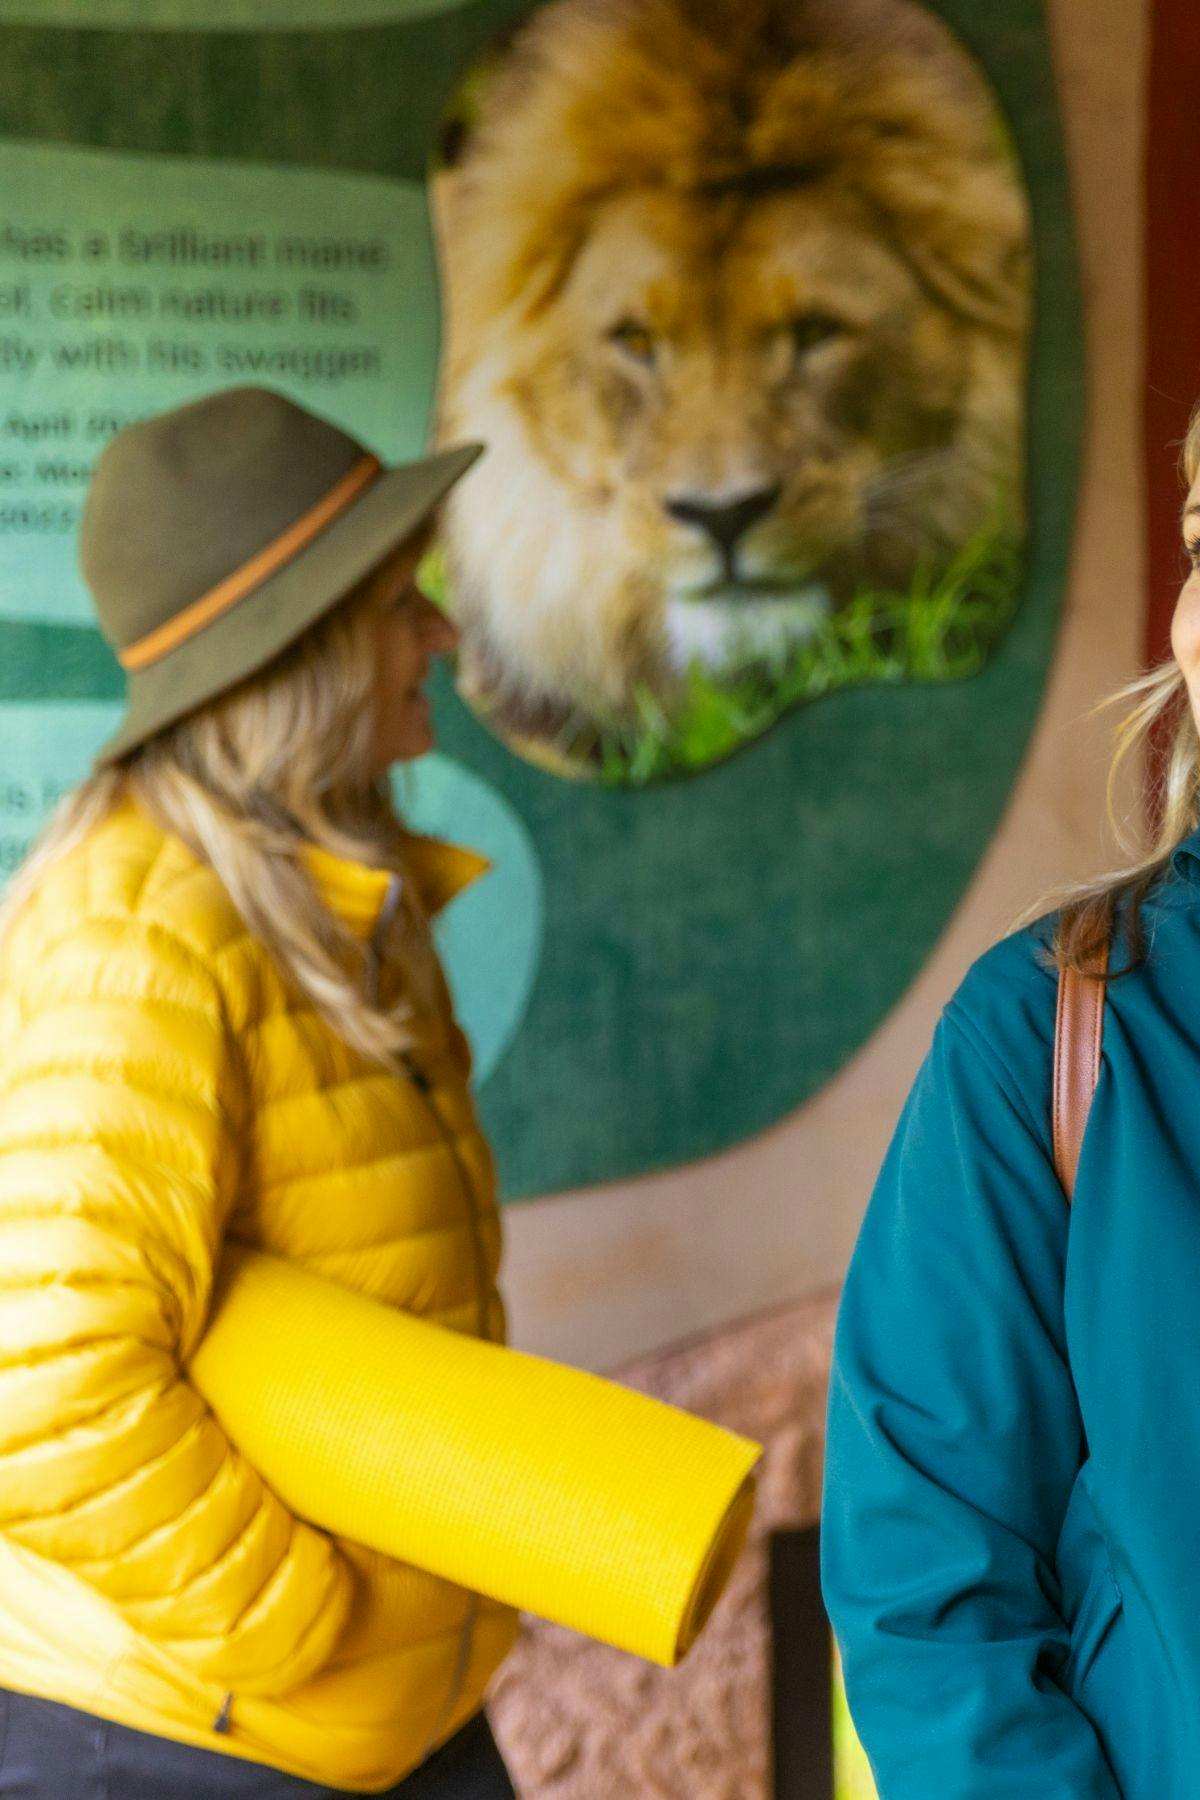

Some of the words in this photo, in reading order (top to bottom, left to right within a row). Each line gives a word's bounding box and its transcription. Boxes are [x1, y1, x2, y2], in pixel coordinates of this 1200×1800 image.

[84, 231, 106, 264] a
[119, 226, 264, 268] brilliant
[52, 281, 150, 319] calm
[161, 287, 288, 323] nature
[300, 283, 358, 325] fits
[53, 335, 136, 374] with
[150, 337, 207, 376] his
[5, 411, 75, 443] April
